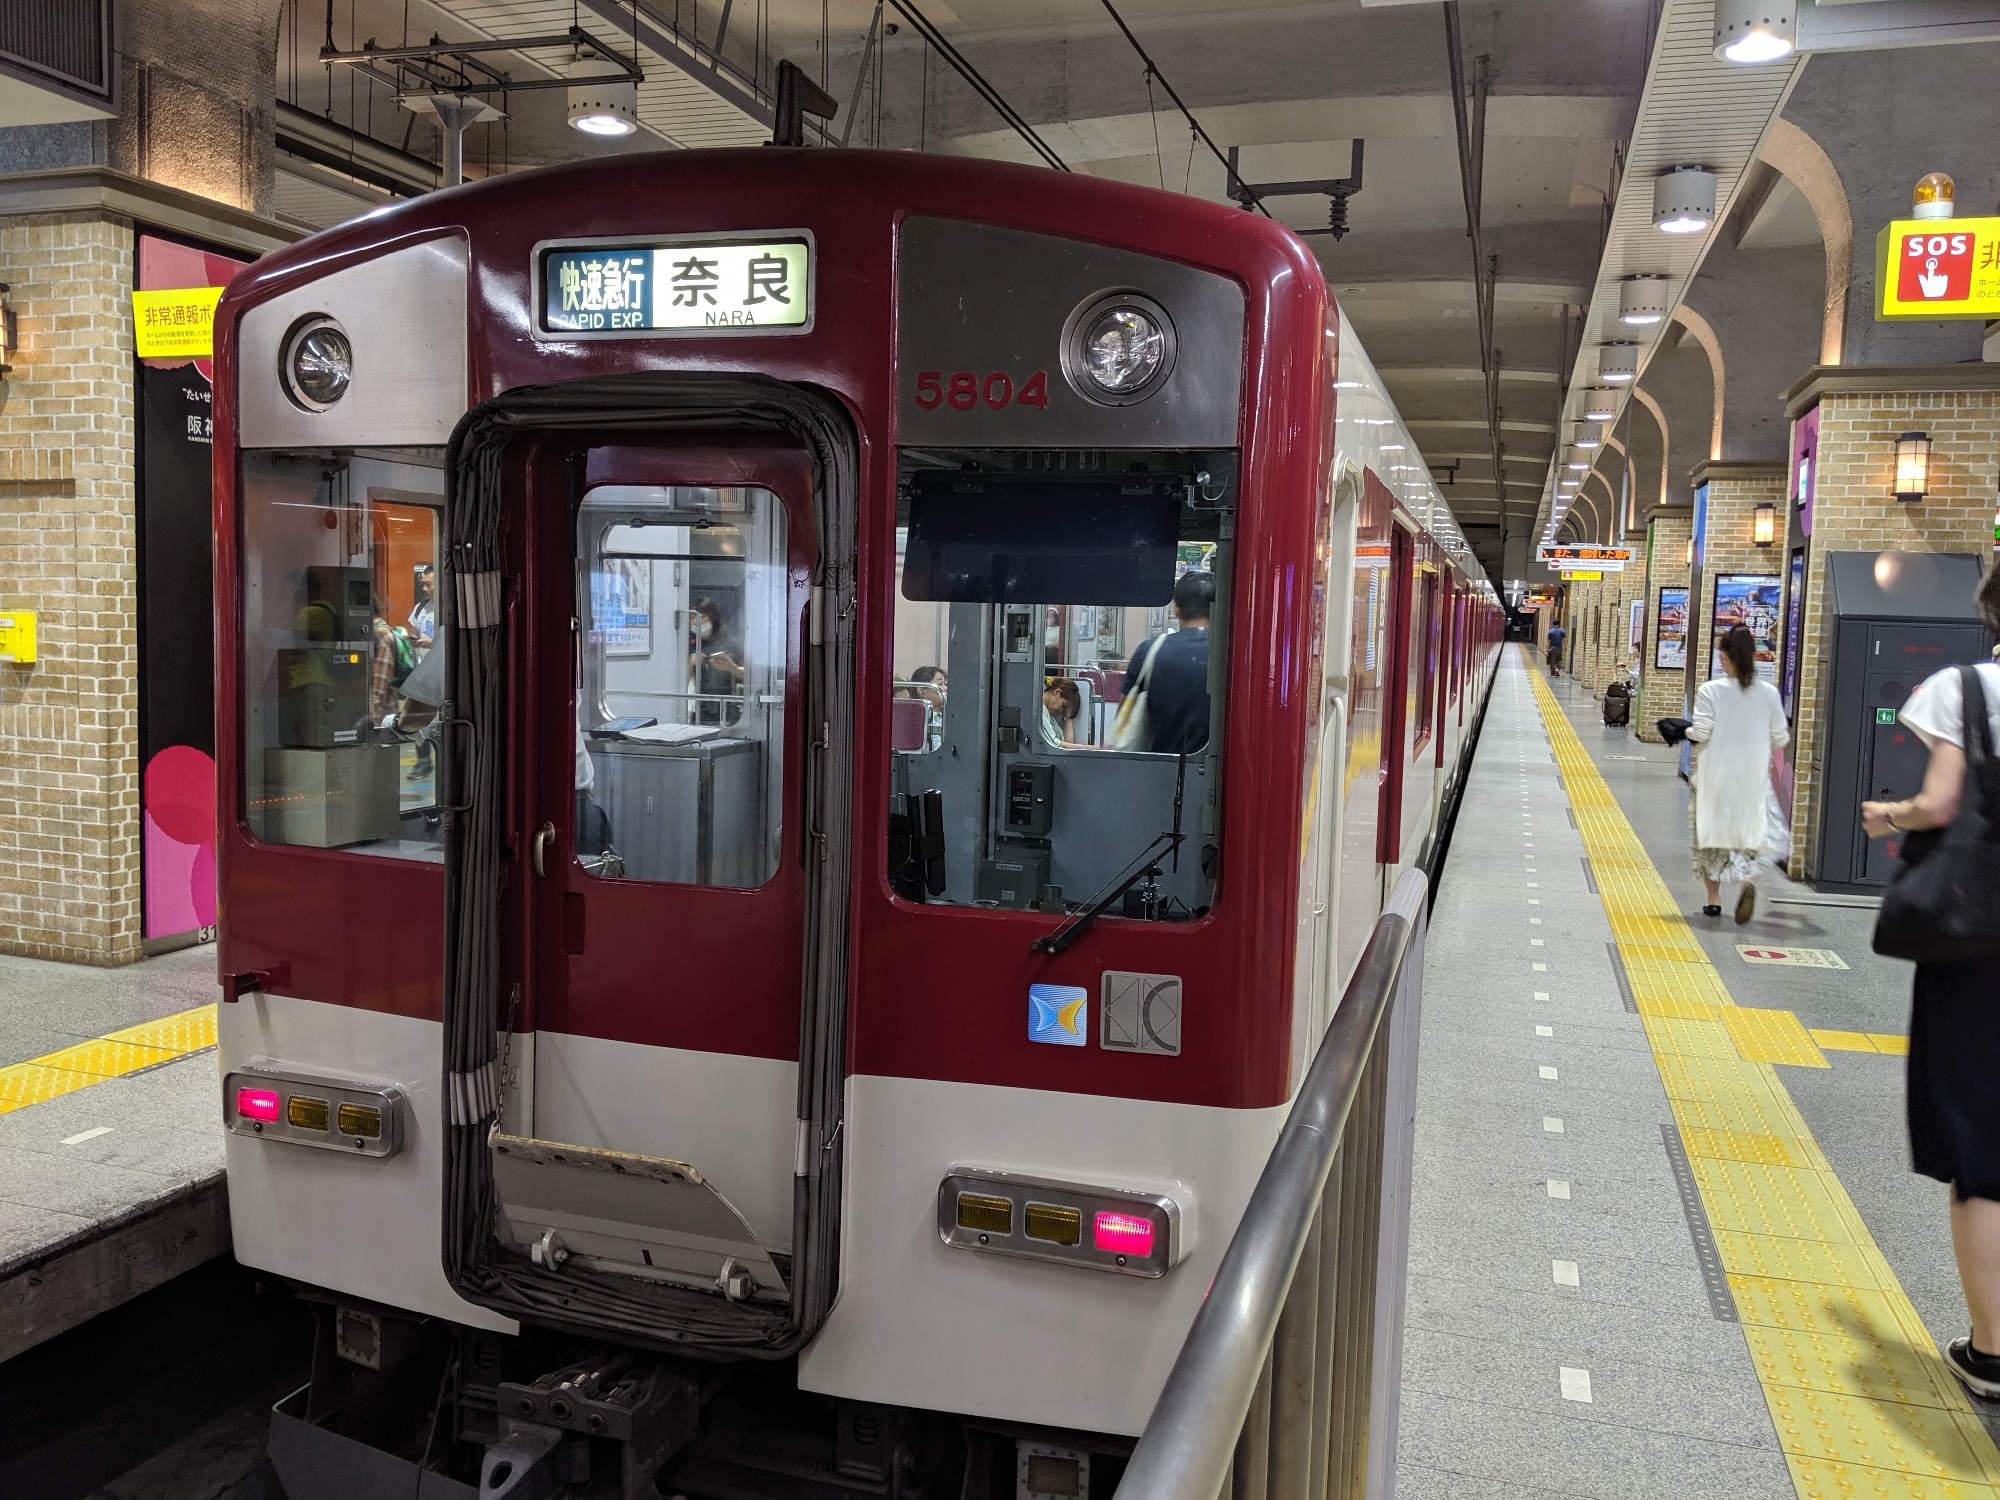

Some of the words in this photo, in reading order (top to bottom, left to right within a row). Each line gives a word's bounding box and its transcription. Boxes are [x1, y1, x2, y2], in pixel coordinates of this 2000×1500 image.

[1908, 235, 1967, 257] SOS
[560, 258, 645, 311] 快速急行
[671, 252, 791, 308] 奈良
[145, 304, 212, 327] 非常通報ボ
[611, 311, 645, 328] EXP.
[705, 310, 755, 326] NARA
[913, 371, 1049, 410] 5804
